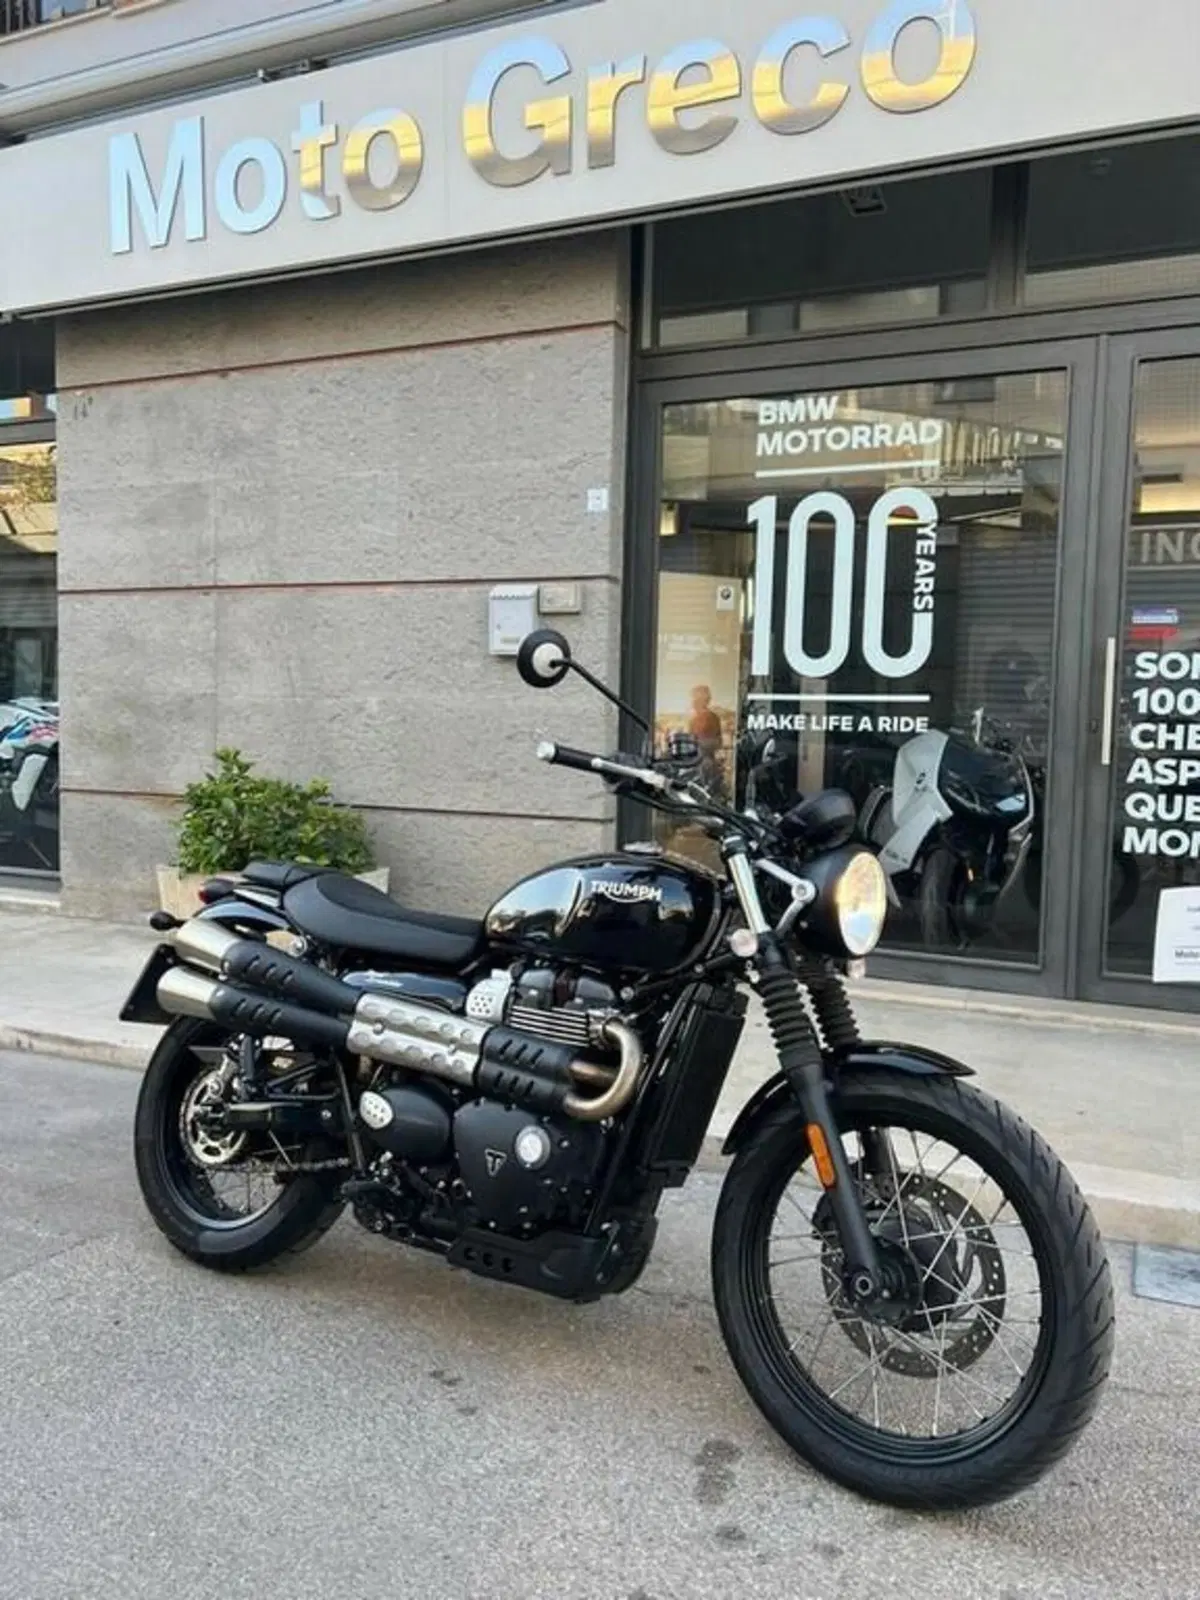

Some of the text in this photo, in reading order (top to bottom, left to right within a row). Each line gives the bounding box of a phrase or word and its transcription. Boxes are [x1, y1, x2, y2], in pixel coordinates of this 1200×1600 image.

[108, 0, 977, 256] Moto Greco
[758, 395, 838, 425] BMW
[756, 418, 943, 457] MOTORRAD
[913, 519, 937, 611] YEARS
[747, 487, 939, 678] 100
[1132, 687, 1200, 715] 100
[747, 714, 929, 733] MAKE LIFE A RIDE
[1126, 757, 1200, 786] ASP
[591, 880, 663, 901] TRIUMPH
